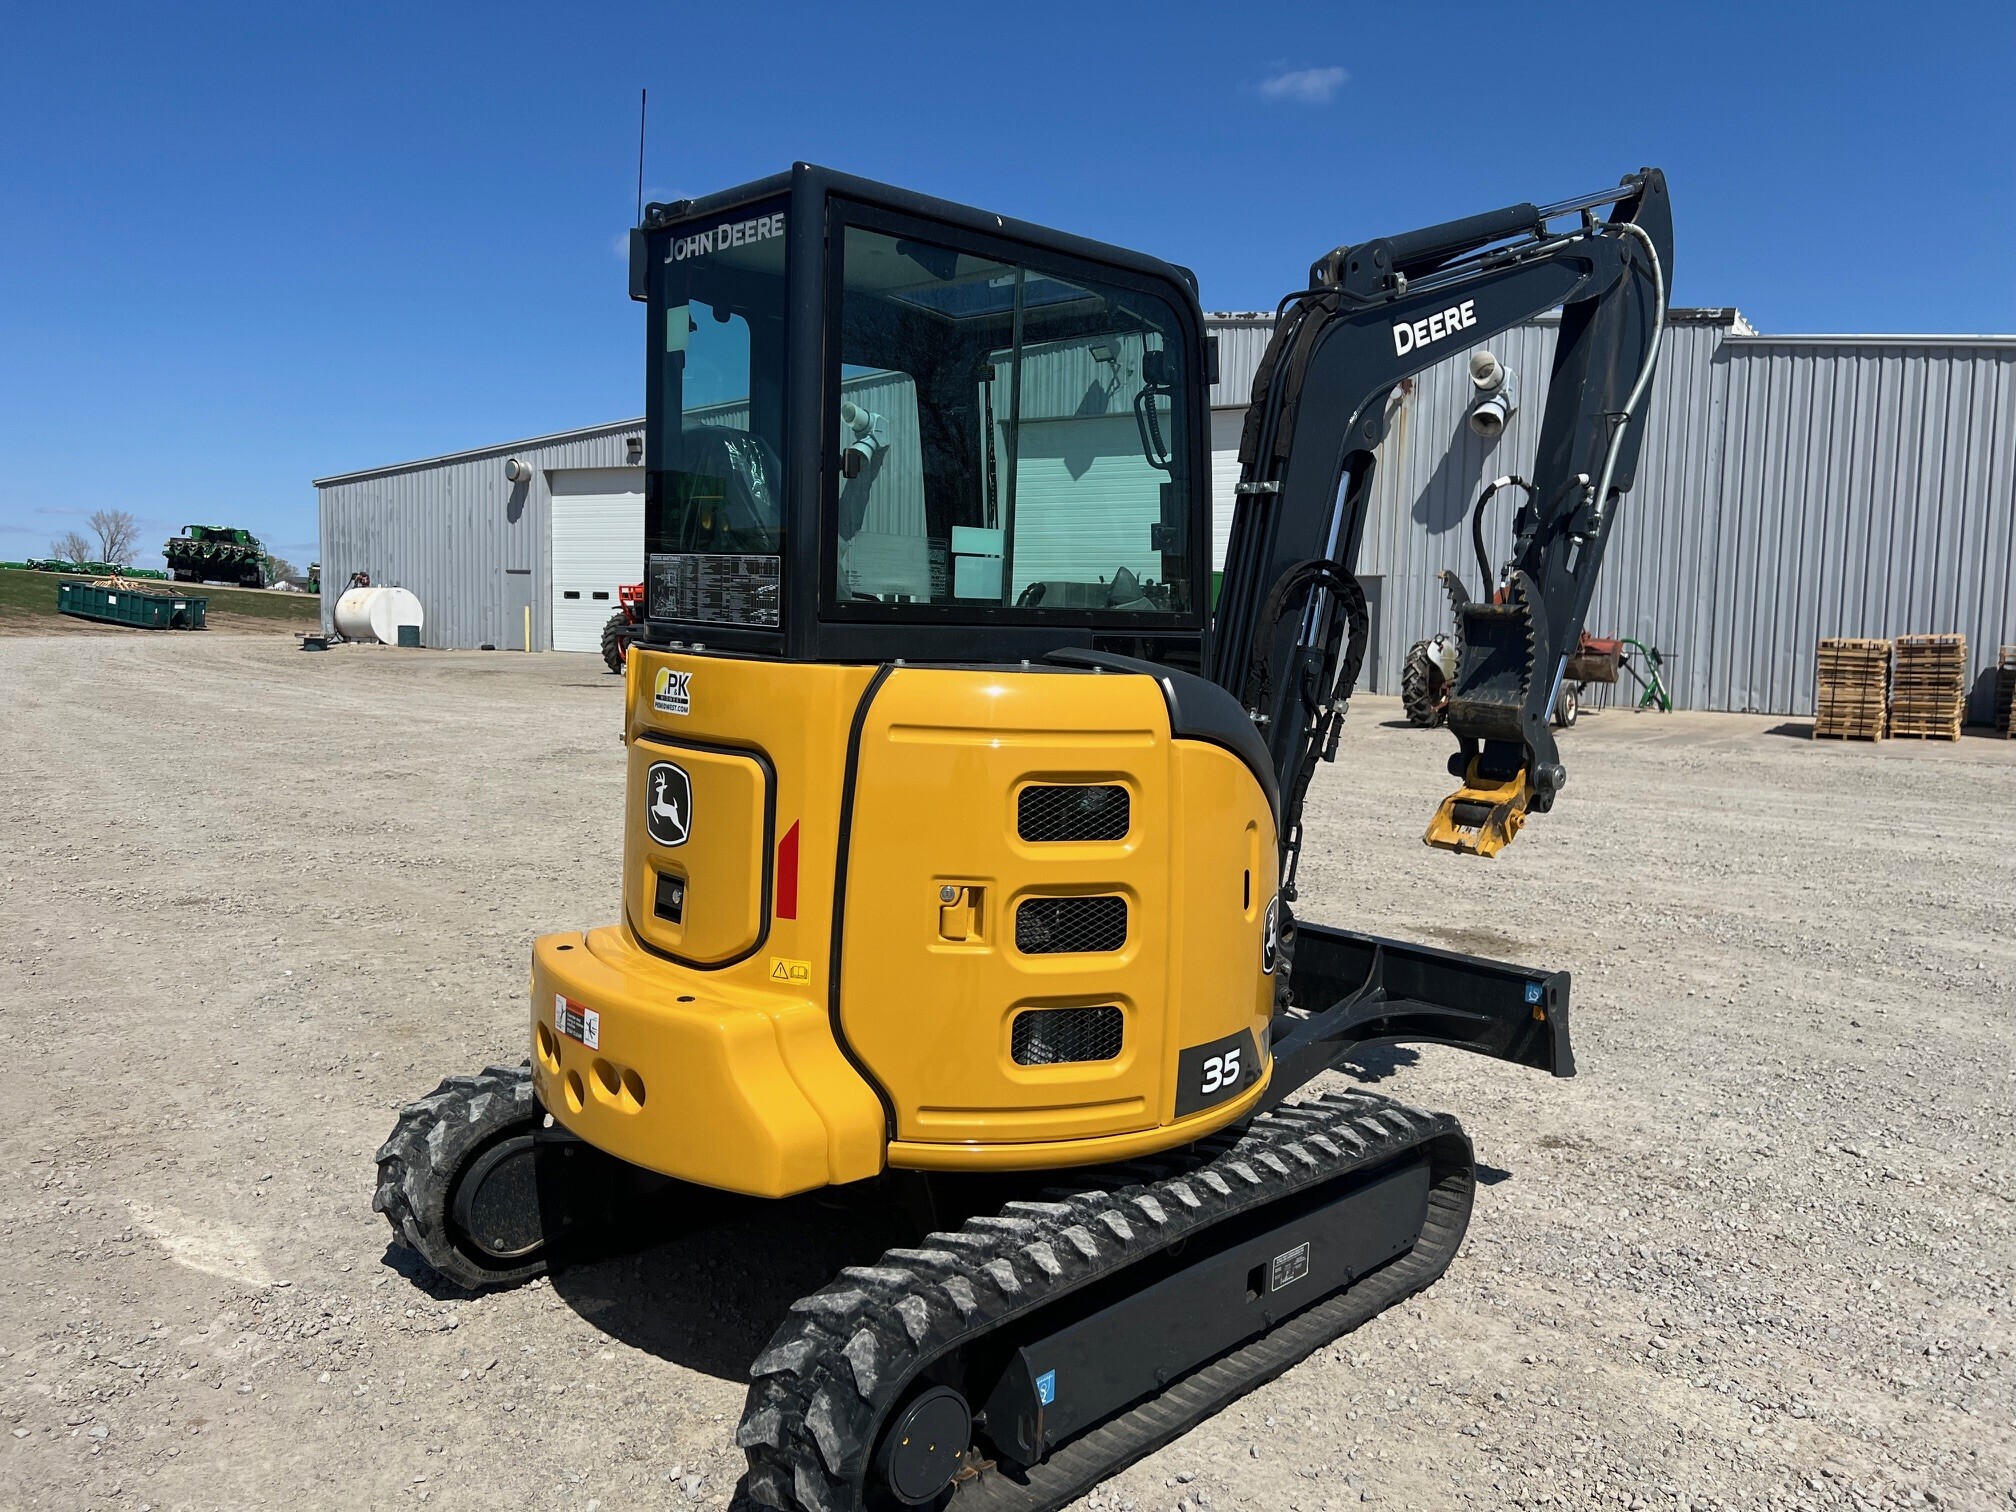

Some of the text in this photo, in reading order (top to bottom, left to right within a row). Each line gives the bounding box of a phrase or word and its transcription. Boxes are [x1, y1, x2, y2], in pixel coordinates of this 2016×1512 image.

[664, 212, 784, 263] JOHN DEERE
[1392, 299, 1477, 356] DEERE
[1201, 1048, 1240, 1094] 35
